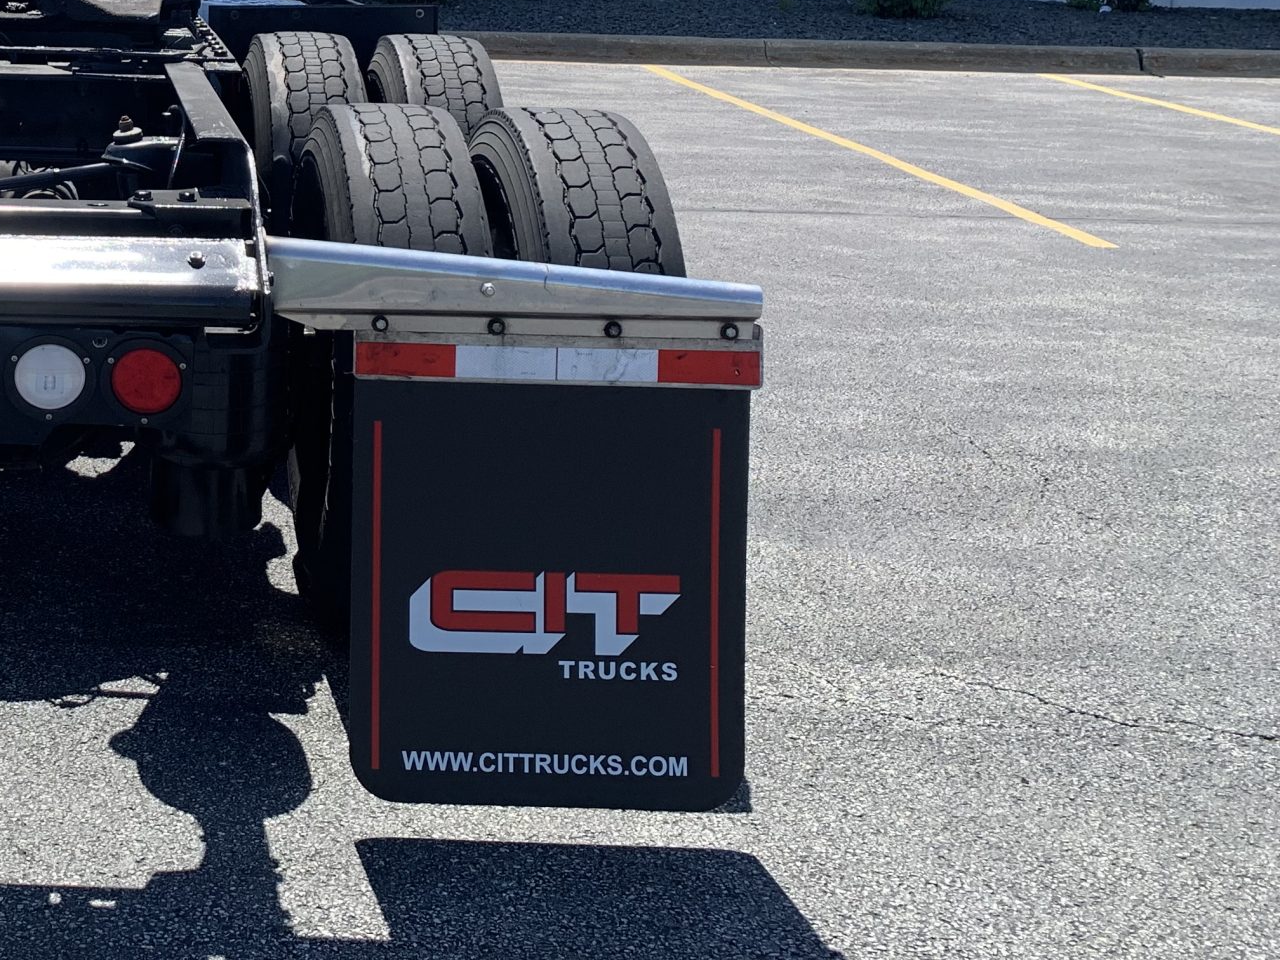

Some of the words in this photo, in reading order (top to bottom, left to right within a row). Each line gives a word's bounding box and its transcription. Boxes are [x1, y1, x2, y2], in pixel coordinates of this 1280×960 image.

[409, 570, 681, 656] CIT
[558, 660, 678, 681] TRUCKS
[401, 750, 688, 777] WWW.CITTRUCKS.COM
